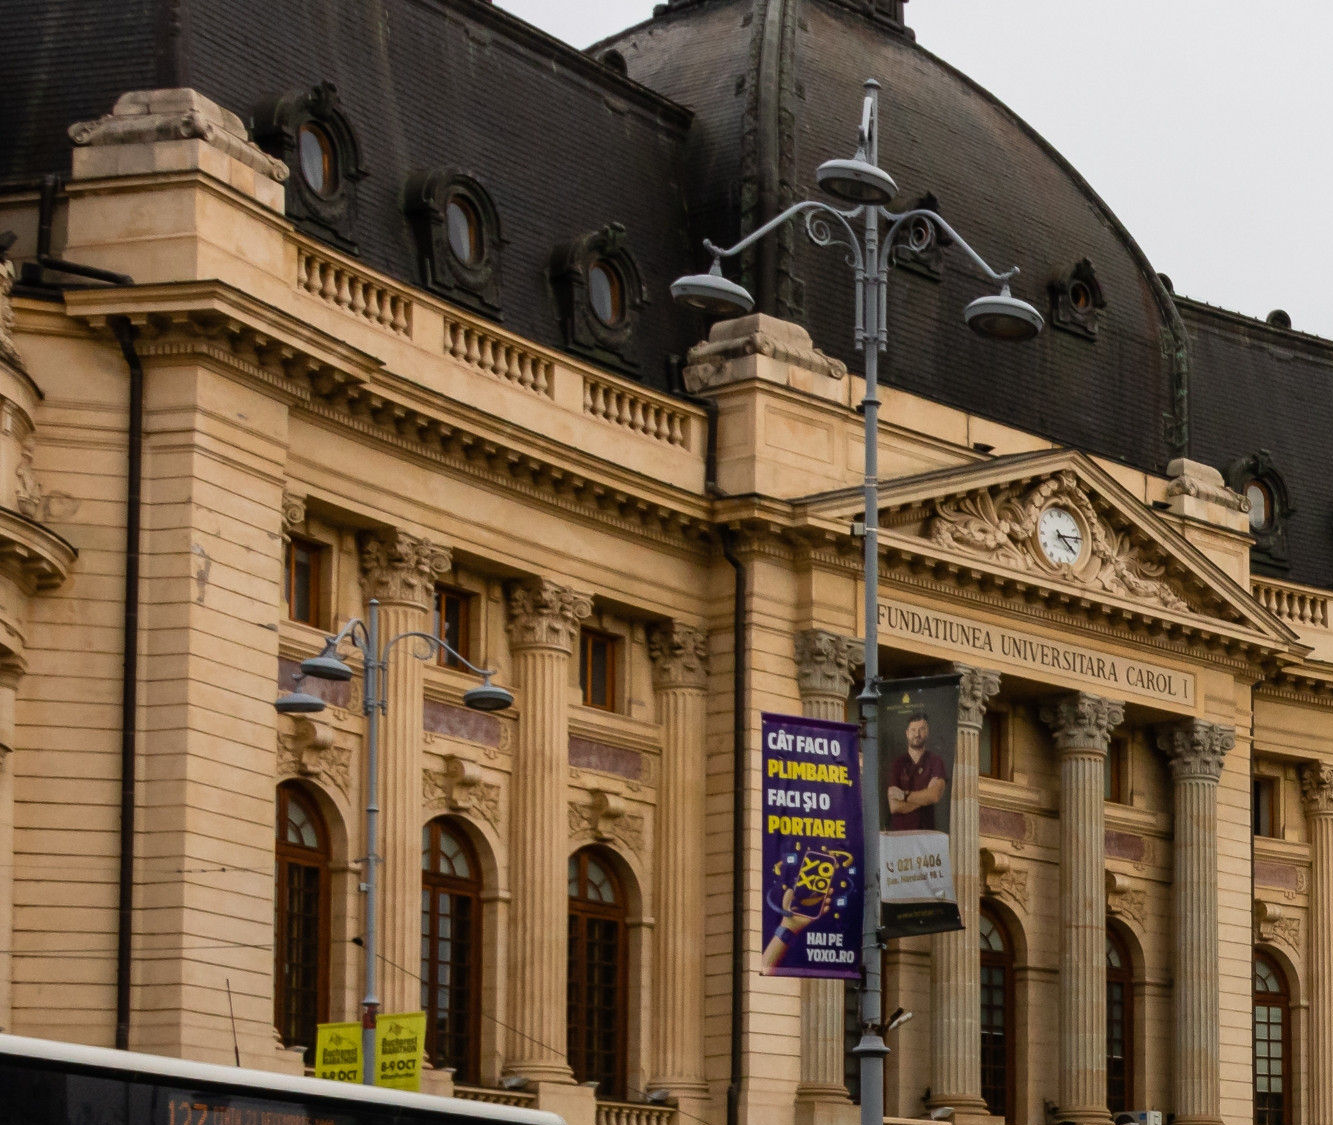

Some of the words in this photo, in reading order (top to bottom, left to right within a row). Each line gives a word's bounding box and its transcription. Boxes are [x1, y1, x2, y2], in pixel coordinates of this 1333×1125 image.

[877, 604, 994, 653] FUNDATIUNEA
[1001, 635, 1118, 682] UNIVERSITARA
[1126, 666, 1177, 696] CAROL
[1182, 678, 1188, 699] I
[767, 729, 794, 751] CÂT
[796, 735, 829, 755] FACI
[831, 740, 840, 757] O
[767, 759, 853, 787] PLIMBARE,
[767, 789, 800, 808] FACI
[803, 792, 817, 812] ȘI
[820, 793, 830, 810] O
[768, 815, 846, 839] PORTARE
[897, 858, 913, 872] 021
[916, 853, 942, 870] 9406
[806, 932, 827, 946] HAI
[828, 933, 843, 947] PE
[806, 948, 855, 963] YOXO.RO
[337, 1070, 358, 1081] OCT
[381, 1060, 395, 1072] 8-9
[396, 1059, 416, 1070] OCT
